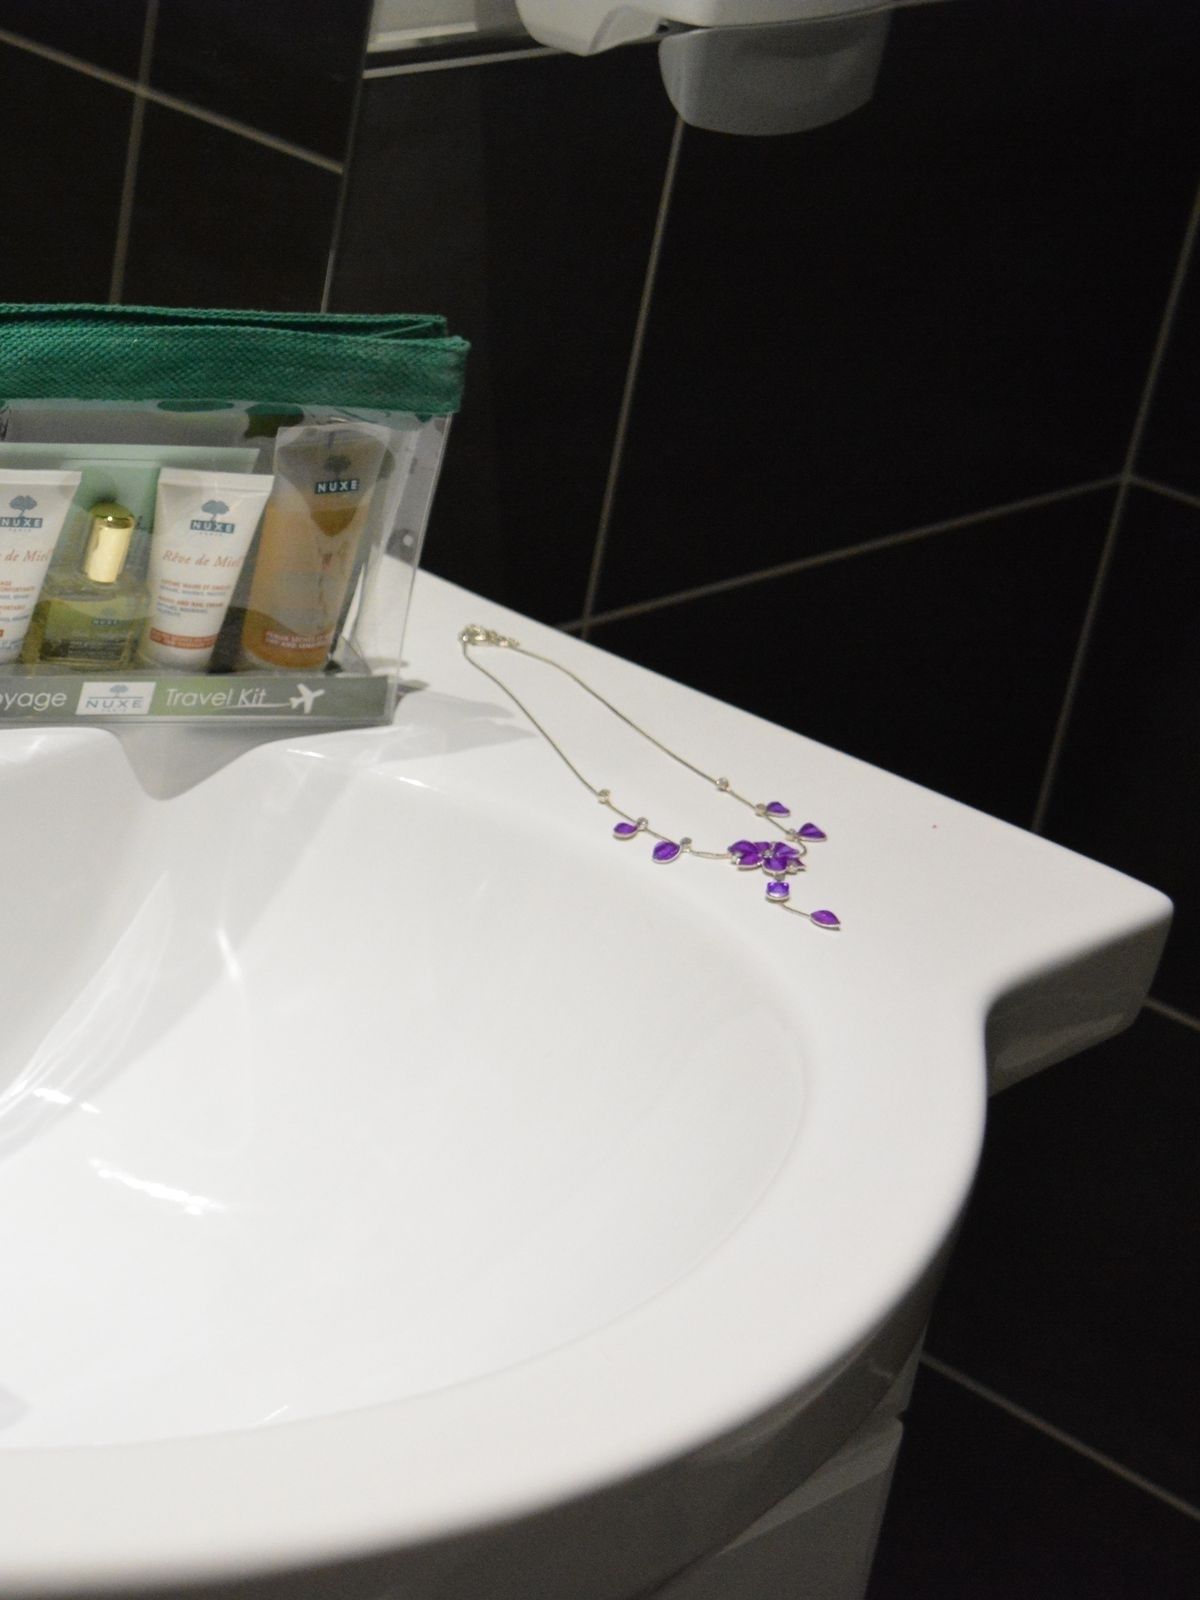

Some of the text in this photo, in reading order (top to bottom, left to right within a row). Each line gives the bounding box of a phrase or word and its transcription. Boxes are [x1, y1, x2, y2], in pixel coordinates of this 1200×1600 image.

[317, 480, 358, 493] NUXE
[0, 517, 42, 528] NUXE
[191, 520, 234, 534] NUXE
[4, 548, 20, 562] de
[162, 550, 192, 565] Rêve
[195, 554, 210, 566] de
[86, 700, 142, 709] NUXE
[165, 688, 266, 707] Travel Kit
